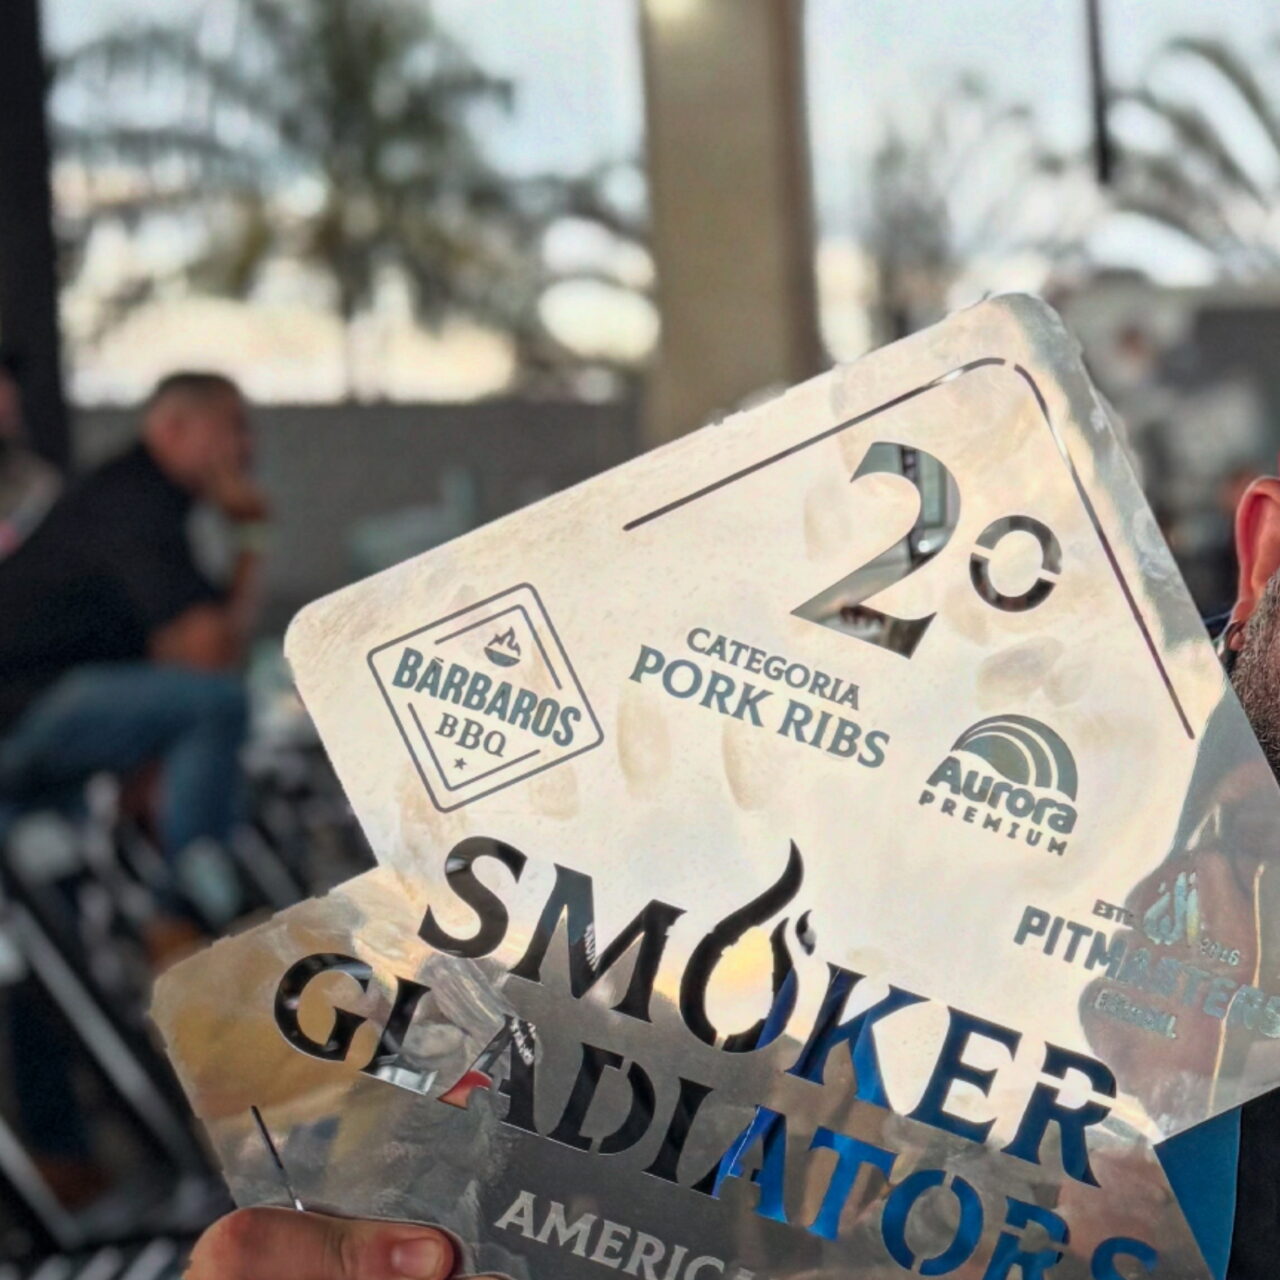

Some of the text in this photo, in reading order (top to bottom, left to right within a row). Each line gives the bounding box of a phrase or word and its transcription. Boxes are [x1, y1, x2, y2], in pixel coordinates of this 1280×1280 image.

[628, 644, 890, 768] PORK RIBS
[686, 627, 860, 711] CATEGORIA
[434, 712, 507, 757] BBQ
[918, 789, 1068, 856] PREMIUM
[926, 755, 1078, 834] Aurora
[417, 836, 1119, 1188] SMOKER
